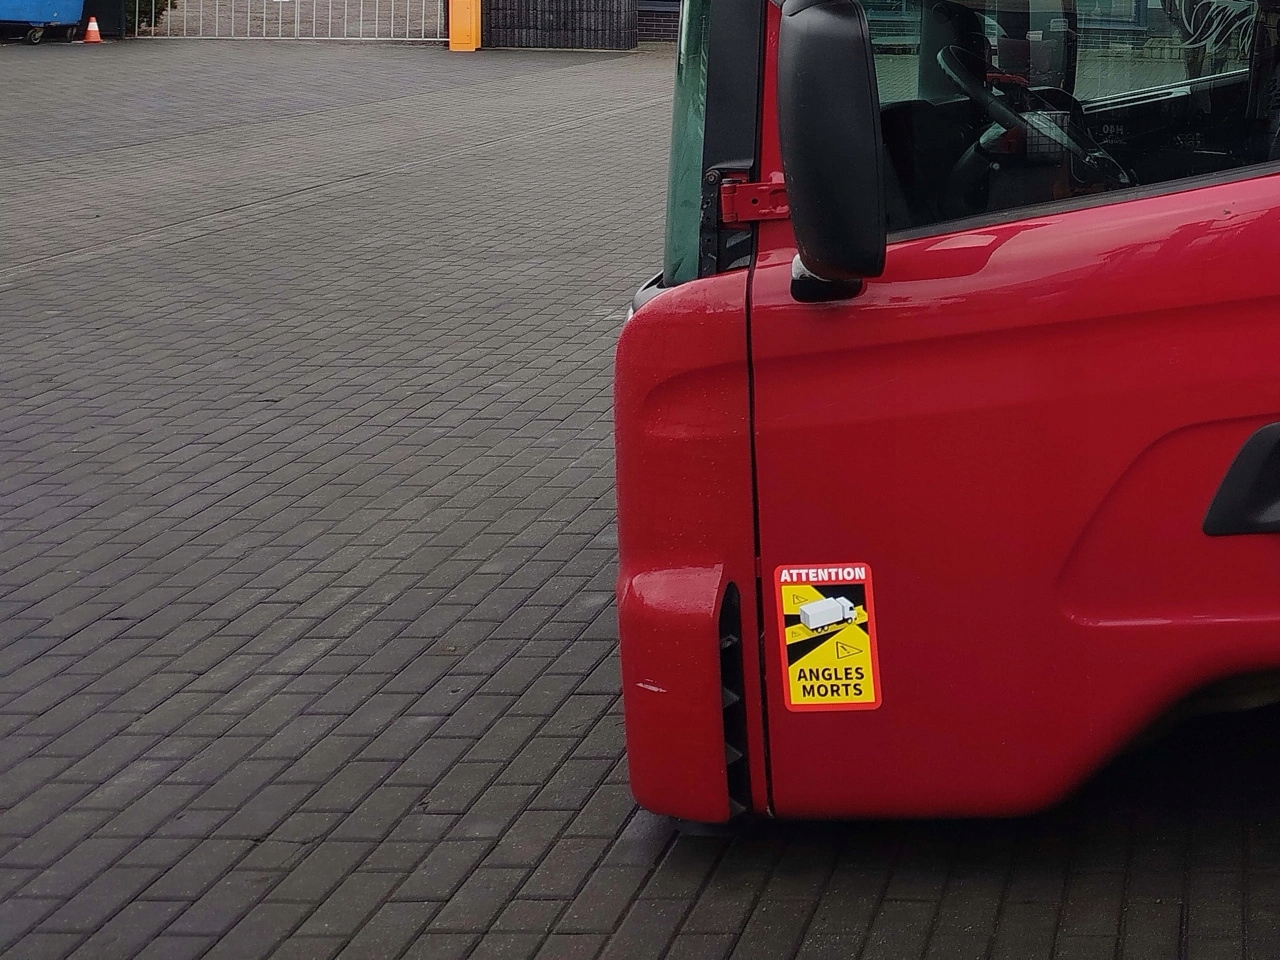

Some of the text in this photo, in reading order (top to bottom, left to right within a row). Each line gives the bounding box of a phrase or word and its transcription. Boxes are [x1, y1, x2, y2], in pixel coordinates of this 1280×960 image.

[780, 567, 866, 582] ATTENTION
[797, 667, 865, 682] ANGLES
[802, 683, 863, 698] MORTS
